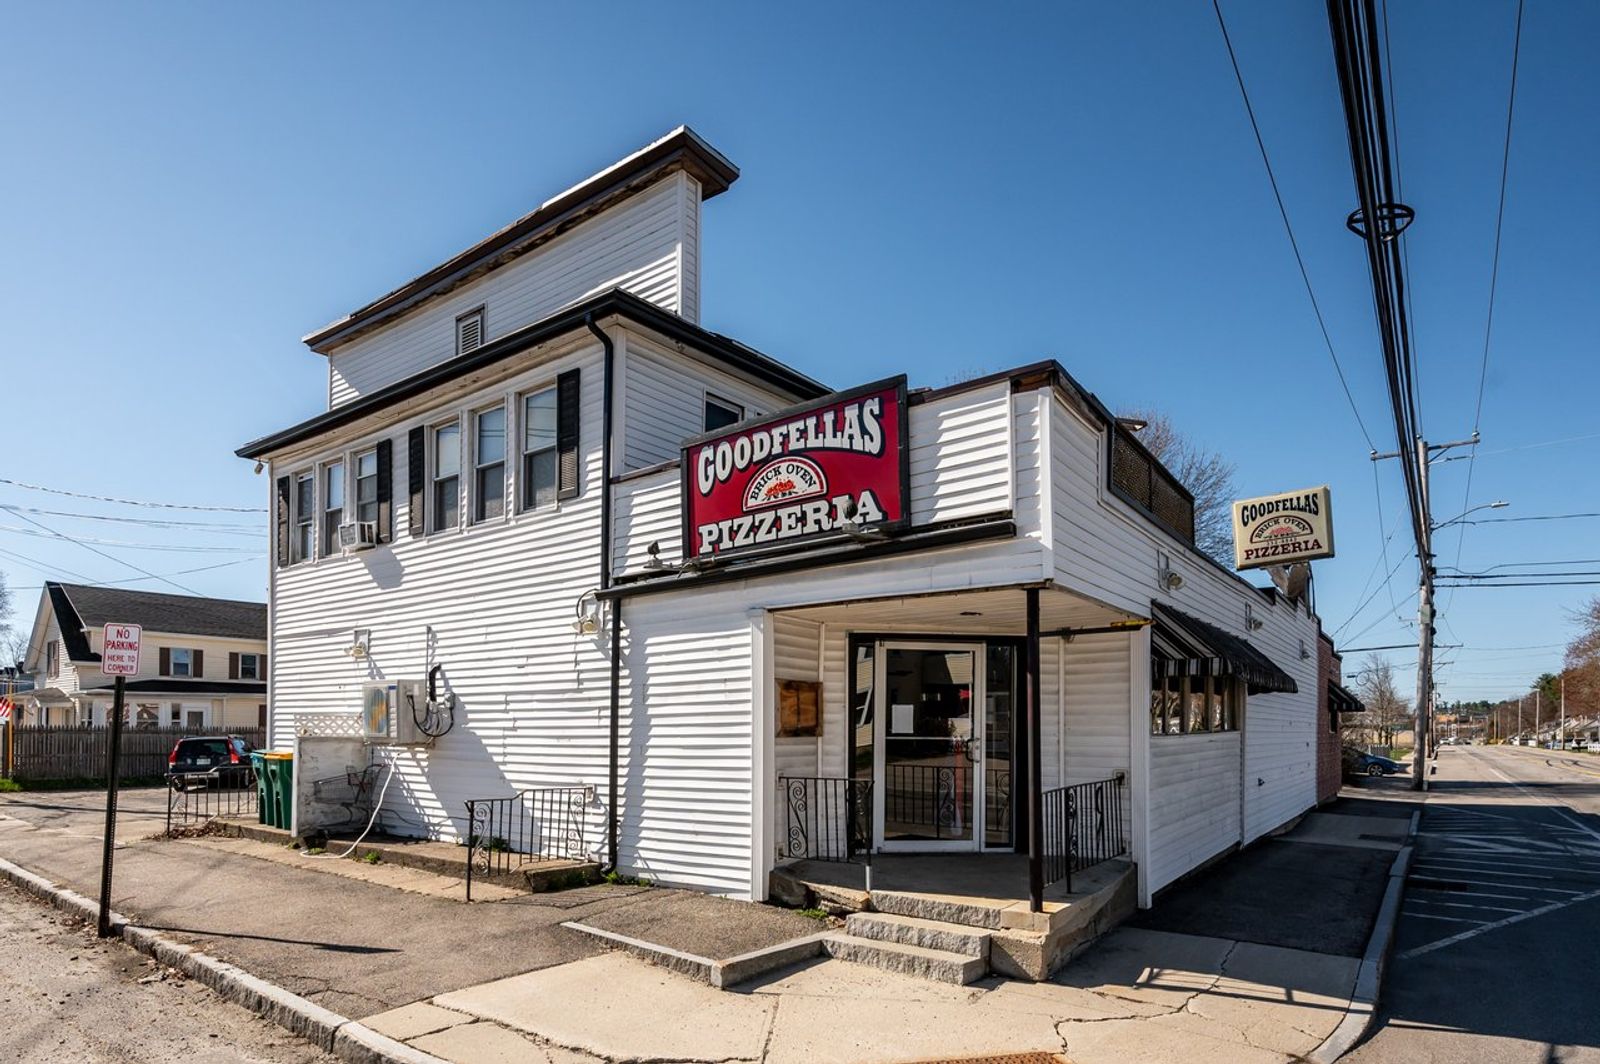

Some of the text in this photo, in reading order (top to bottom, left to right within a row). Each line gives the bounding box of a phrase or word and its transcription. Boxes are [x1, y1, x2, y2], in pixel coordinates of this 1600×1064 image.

[698, 397, 883, 494] GOODFELLAS
[750, 463, 817, 501] BRICK OVEN
[1241, 493, 1319, 527] GOODFELLAS
[698, 490, 883, 554] PIZZERIA
[1255, 517, 1308, 538] BRICK OVEN
[1244, 539, 1322, 560] PIZZERIA
[116, 629, 130, 639] NO
[106, 640, 138, 651] PARKING
[107, 654, 124, 662] HERE
[107, 663, 134, 672] CORNER
